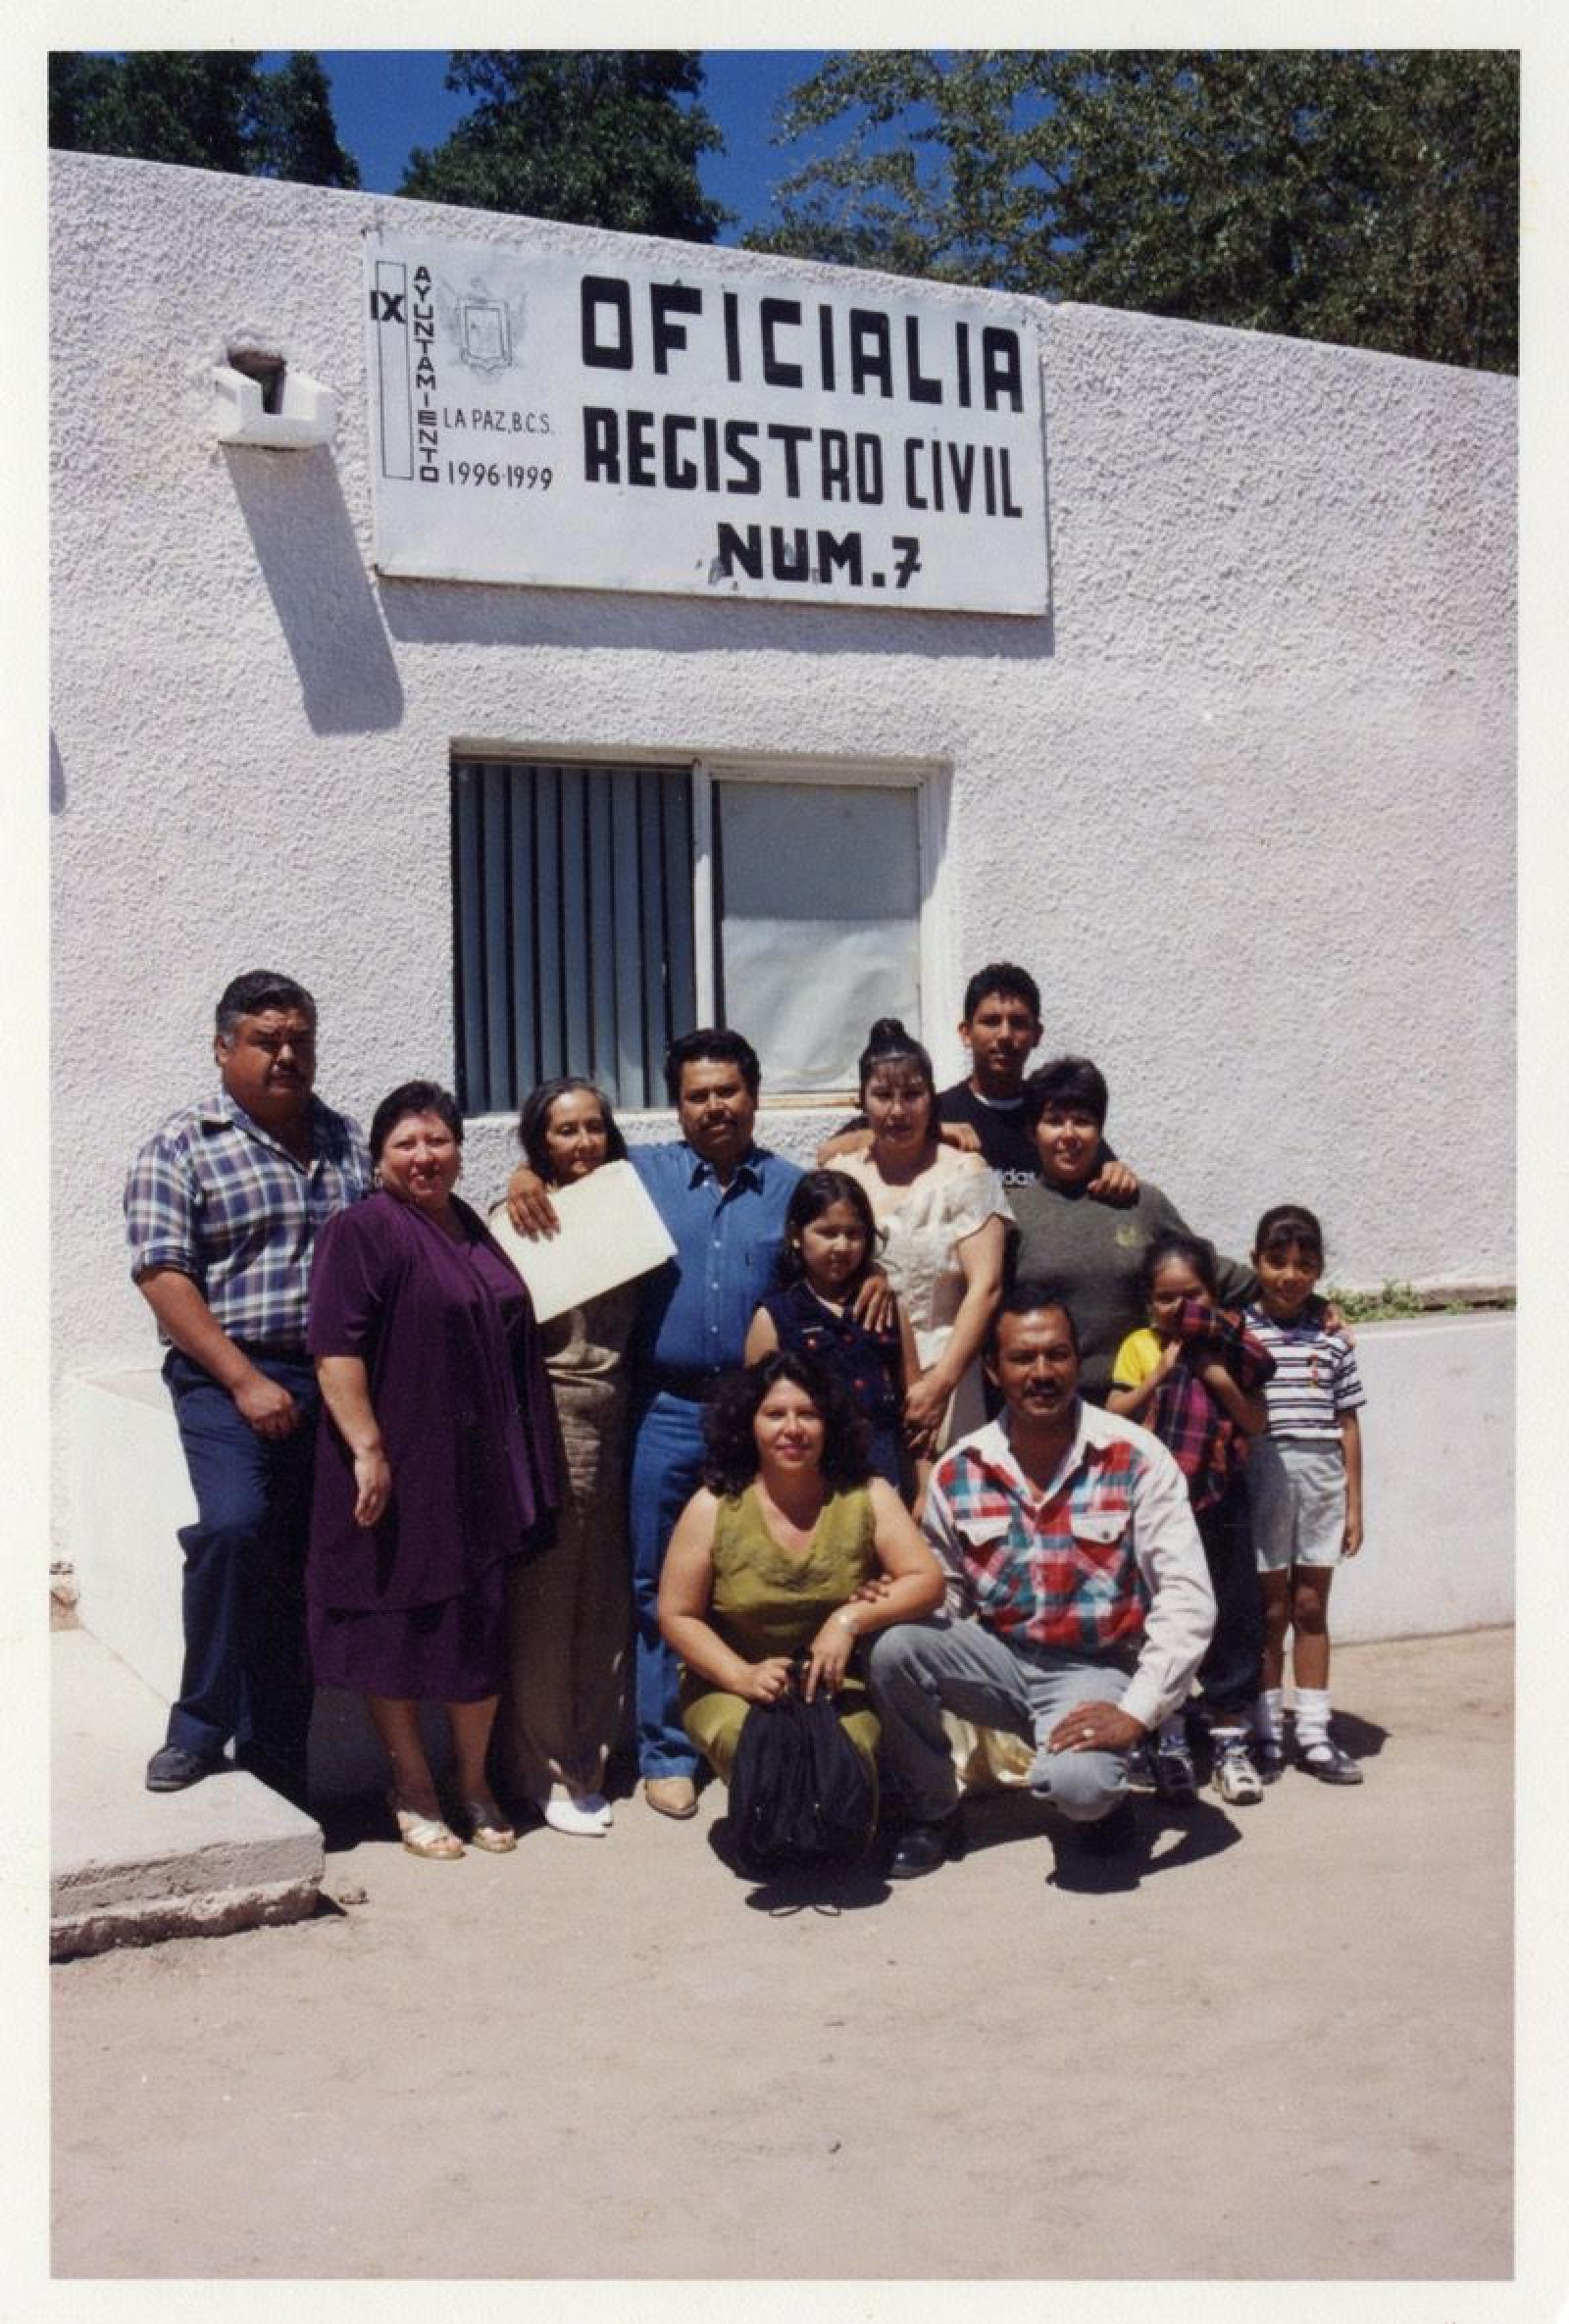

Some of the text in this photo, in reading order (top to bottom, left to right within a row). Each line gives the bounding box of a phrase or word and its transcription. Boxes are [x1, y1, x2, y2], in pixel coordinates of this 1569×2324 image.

[370, 290, 408, 324] IX
[581, 275, 1025, 414] OFICIALIA
[413, 265, 439, 483] AYUNTAMIENTO
[443, 407, 468, 429] LA
[582, 405, 1025, 519] REGISTRO CIVIL
